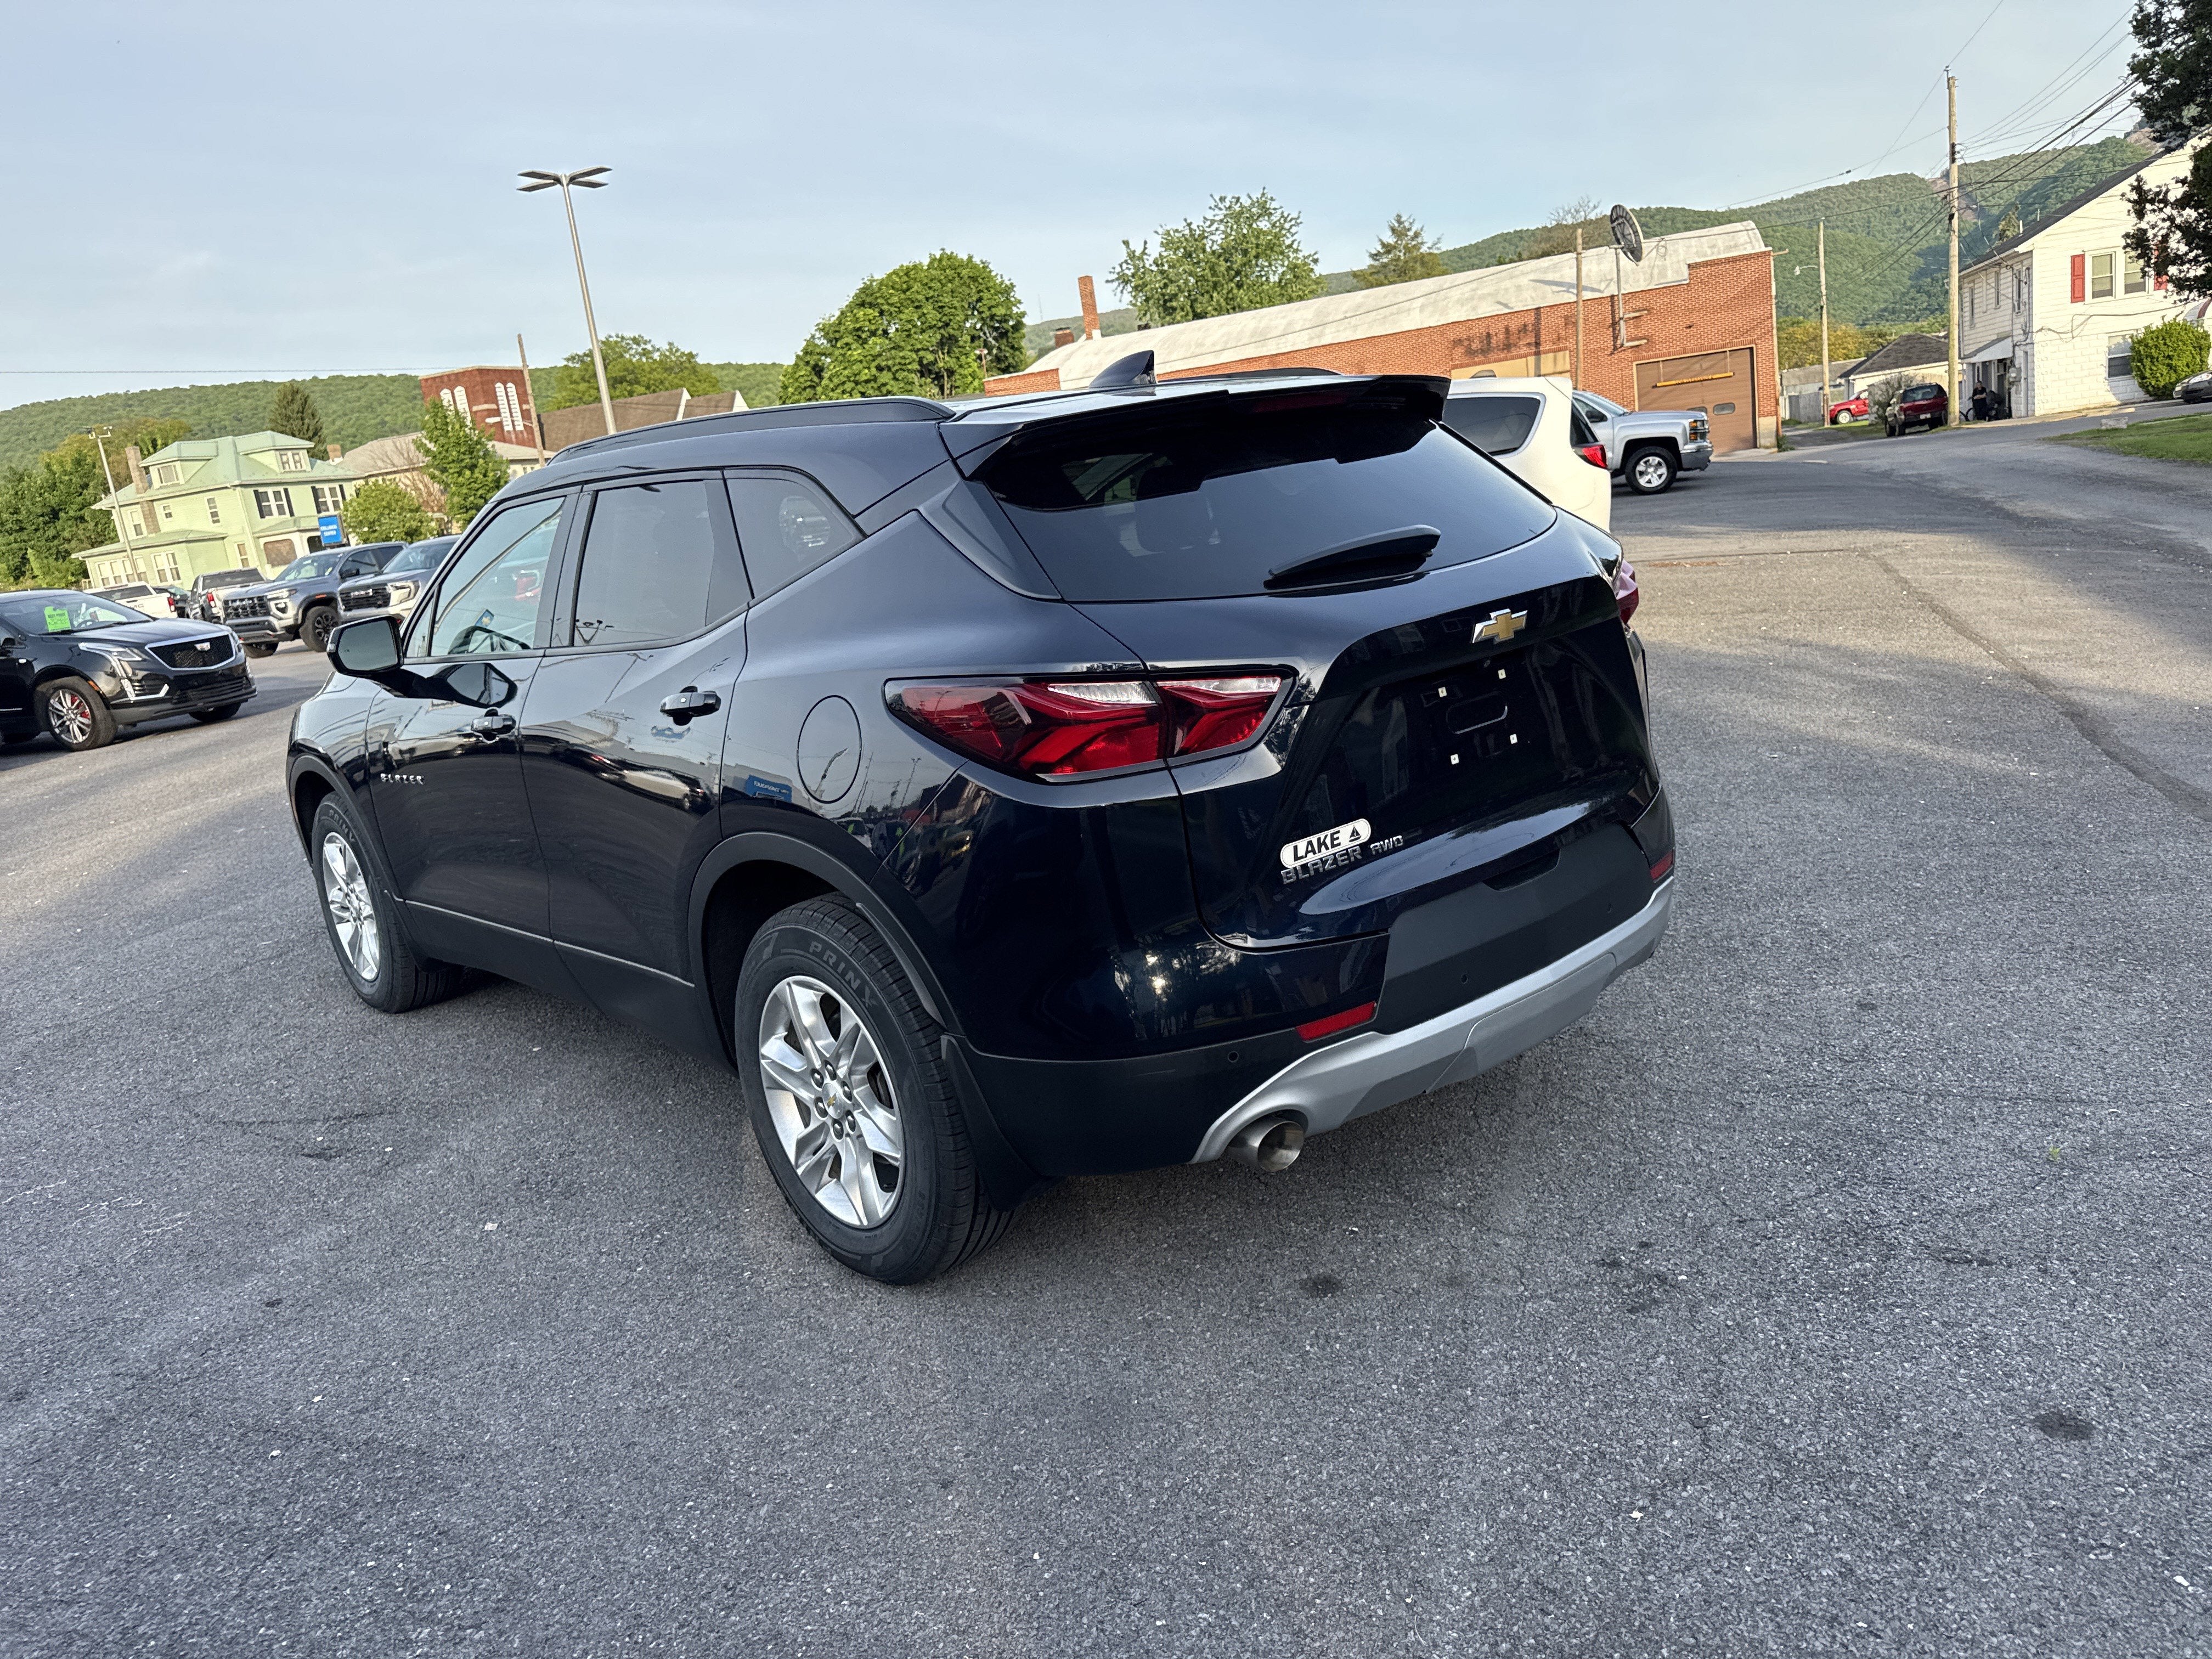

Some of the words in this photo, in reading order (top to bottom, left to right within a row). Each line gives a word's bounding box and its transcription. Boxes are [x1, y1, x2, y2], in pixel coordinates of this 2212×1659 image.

[381, 773, 425, 785] BLAZER
[1281, 845, 1363, 884] BLAZER
[1369, 835, 1404, 856] AWD
[1293, 830, 1341, 862] LAKE
